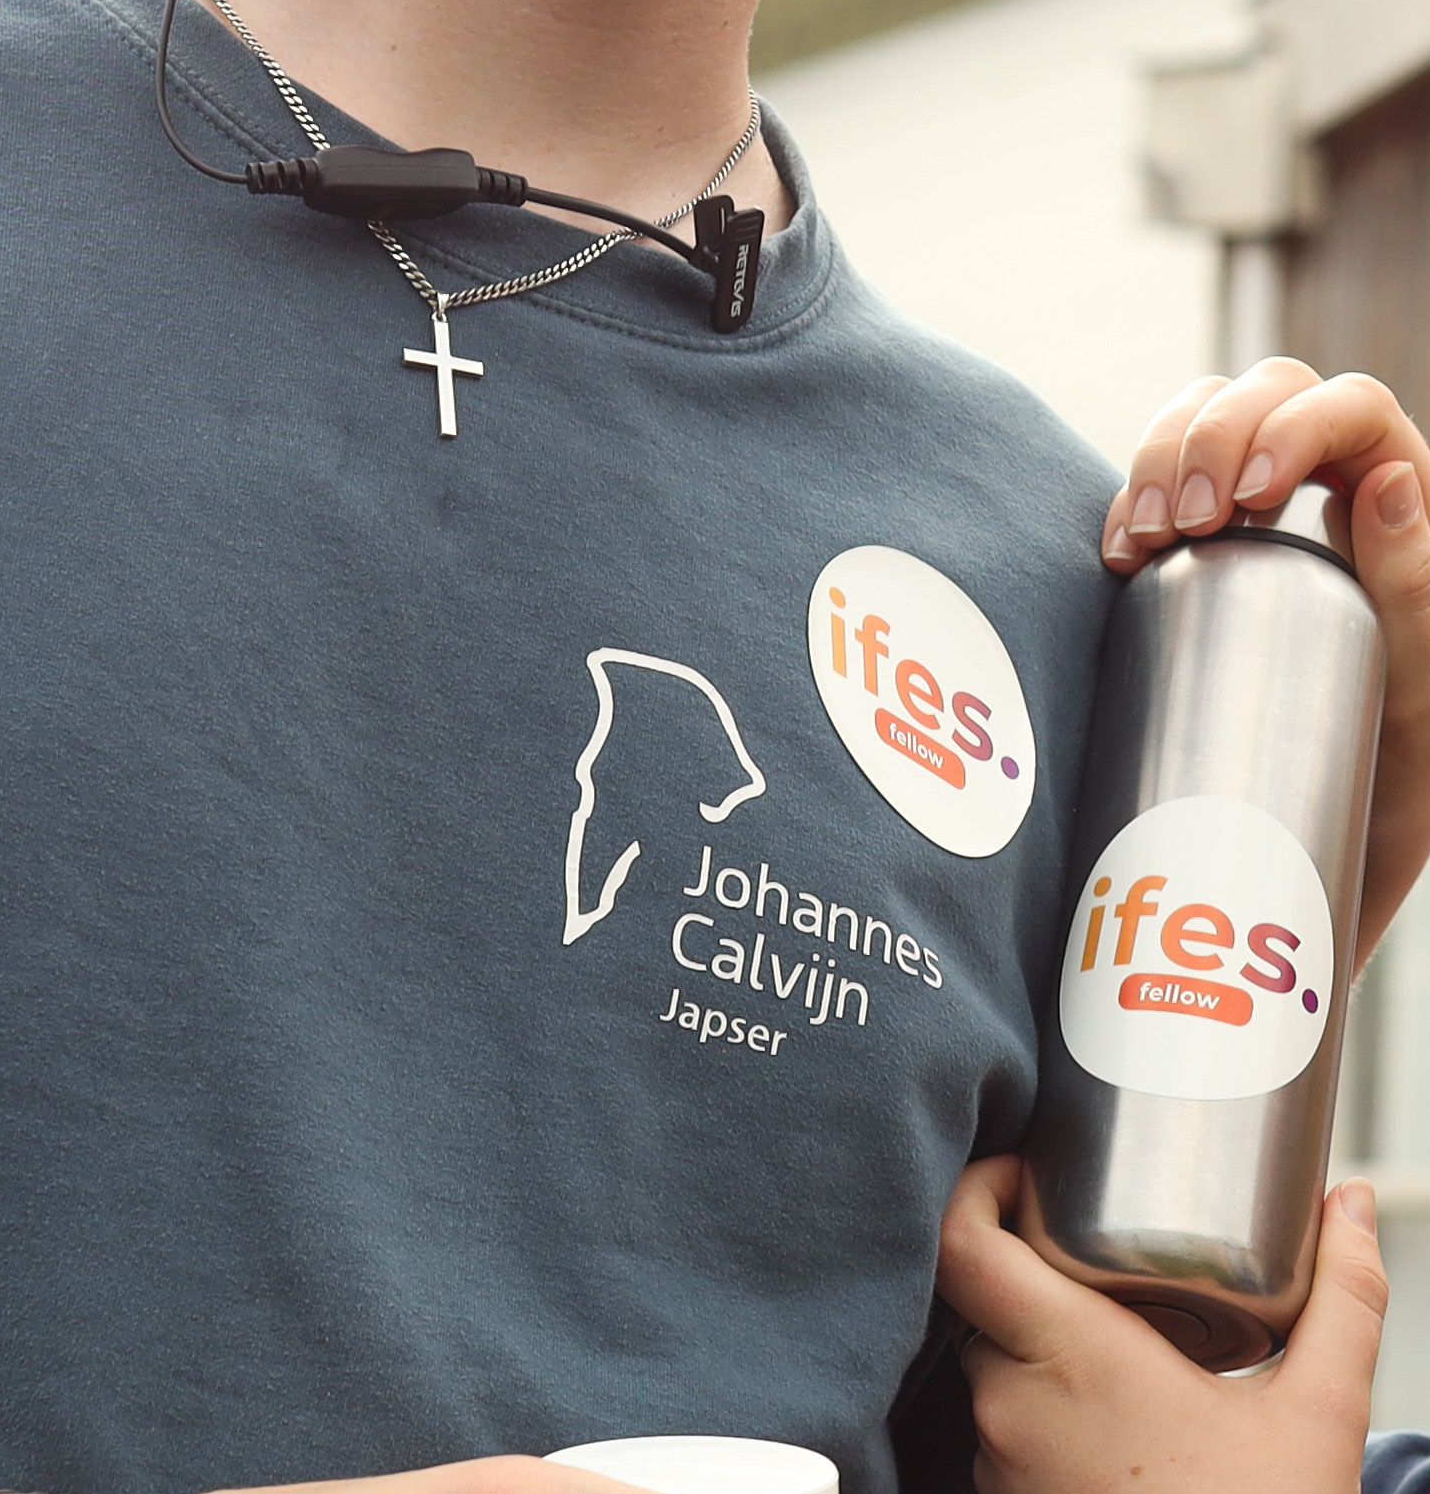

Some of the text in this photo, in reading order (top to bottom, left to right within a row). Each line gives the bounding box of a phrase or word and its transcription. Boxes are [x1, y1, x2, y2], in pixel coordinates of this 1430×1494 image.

[888, 721, 945, 771] fellow
[682, 845, 944, 989] Johannes
[671, 912, 870, 1027] Calvijn
[1138, 980, 1222, 1012] fellow
[659, 987, 789, 1057] Japser
